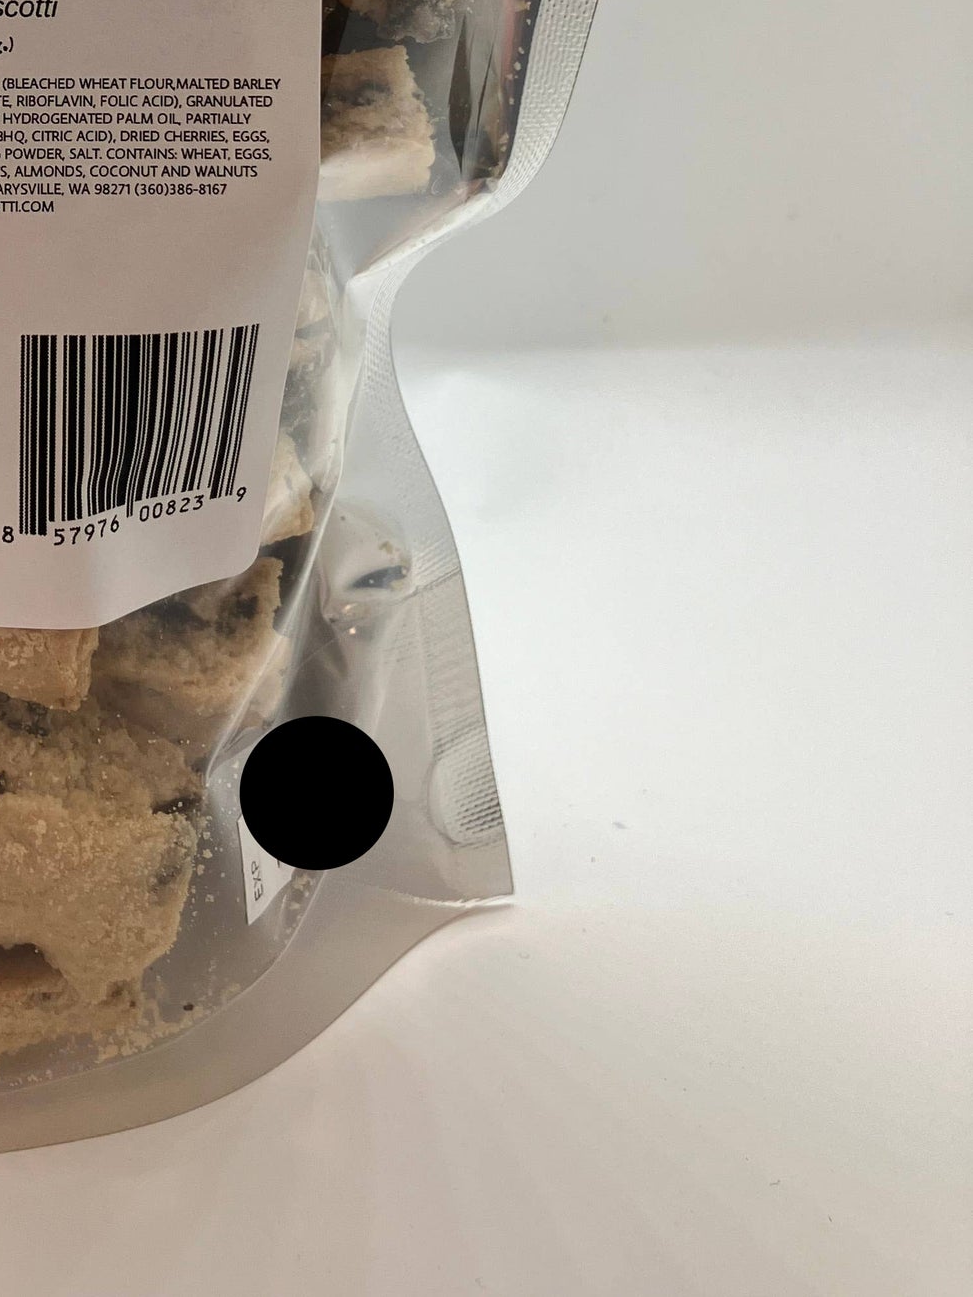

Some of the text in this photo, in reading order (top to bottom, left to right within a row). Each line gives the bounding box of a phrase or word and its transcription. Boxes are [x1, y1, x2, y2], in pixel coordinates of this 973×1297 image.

[1, 77, 76, 93] (BLEACHED
[78, 77, 128, 90] WHEAT
[233, 77, 282, 91] BARLEY
[16, 94, 97, 112] RIBOFLAVIN,
[99, 94, 139, 108] FOLIC
[141, 94, 183, 110] ACID),
[185, 94, 274, 108] GRANULATED
[2, 110, 114, 129] HYDROGENATED
[116, 112, 154, 125] PALM
[156, 112, 182, 127] OIL,
[185, 112, 252, 125] PARTIALLY
[31, 129, 74, 143] CITRIC
[75, 129, 117, 145] ACID),
[119, 129, 161, 143] DRIED
[163, 129, 229, 144] CHERRIES,
[232, 130, 271, 144] EGGS,
[4, 146, 66, 165] POWDER,
[105, 147, 178, 161] CONTAINS:
[234, 147, 273, 162] EGGS,
[13, 164, 87, 180] ALMONDS,
[89, 164, 159, 178] COCONUT
[160, 164, 192, 178] AND
[193, 164, 259, 178] WALNUTS
[67, 182, 91, 196] WA
[94, 182, 131, 196] 98271
[134, 182, 228, 197] (360)386-8167
[1, 486, 247, 546] 8 57976 00823 9
[251, 860, 264, 902] EXP
